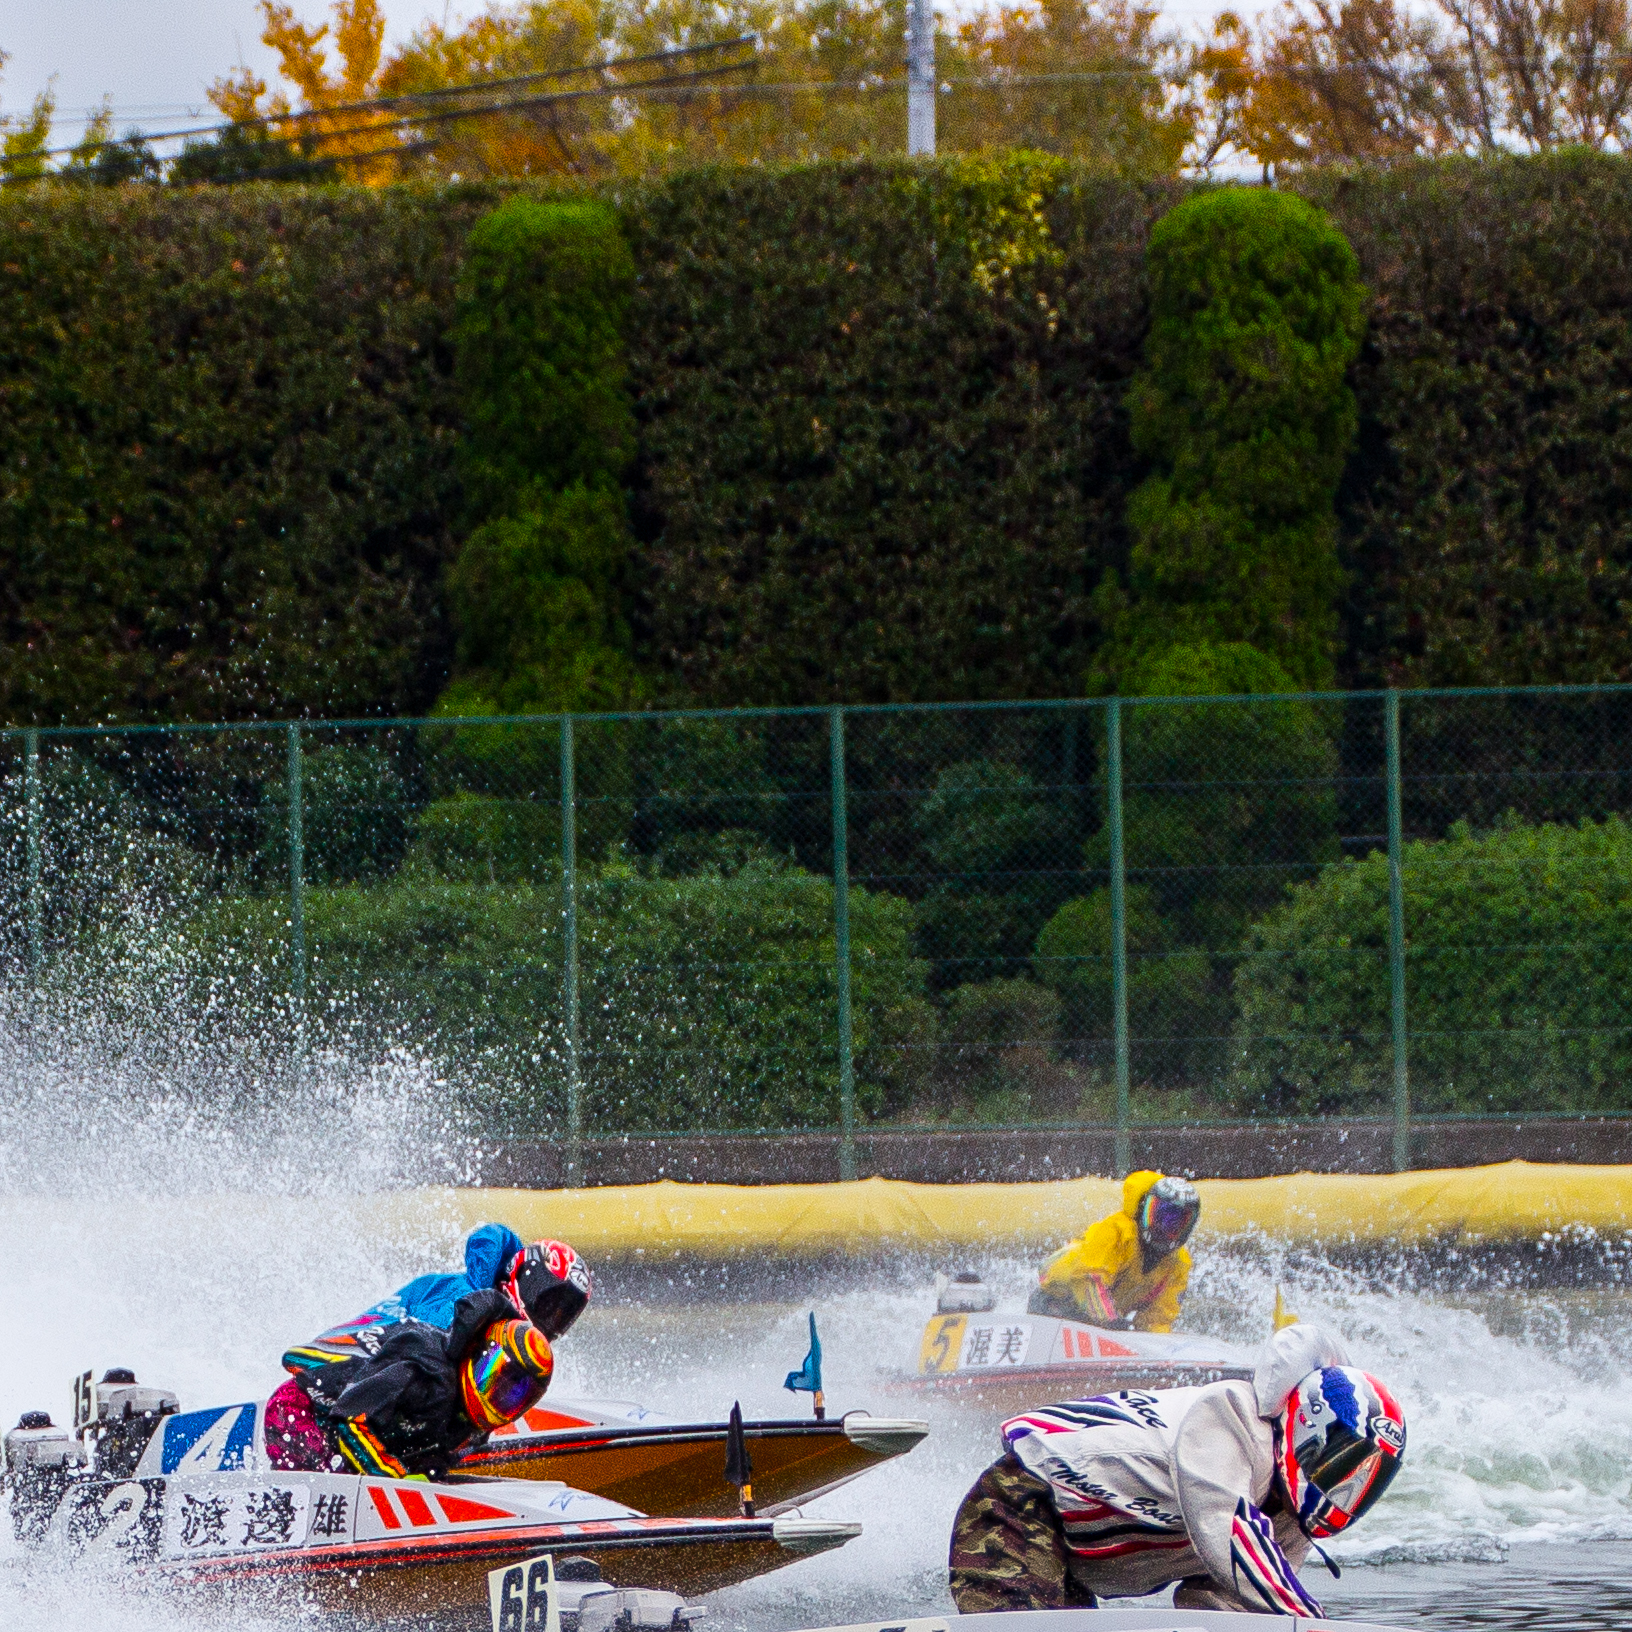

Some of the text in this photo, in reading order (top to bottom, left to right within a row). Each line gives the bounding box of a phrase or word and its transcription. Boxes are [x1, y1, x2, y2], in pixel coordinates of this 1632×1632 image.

[924, 1317, 960, 1372] 5
[966, 1327, 1024, 1364] 渥美
[174, 1405, 245, 1473] 4
